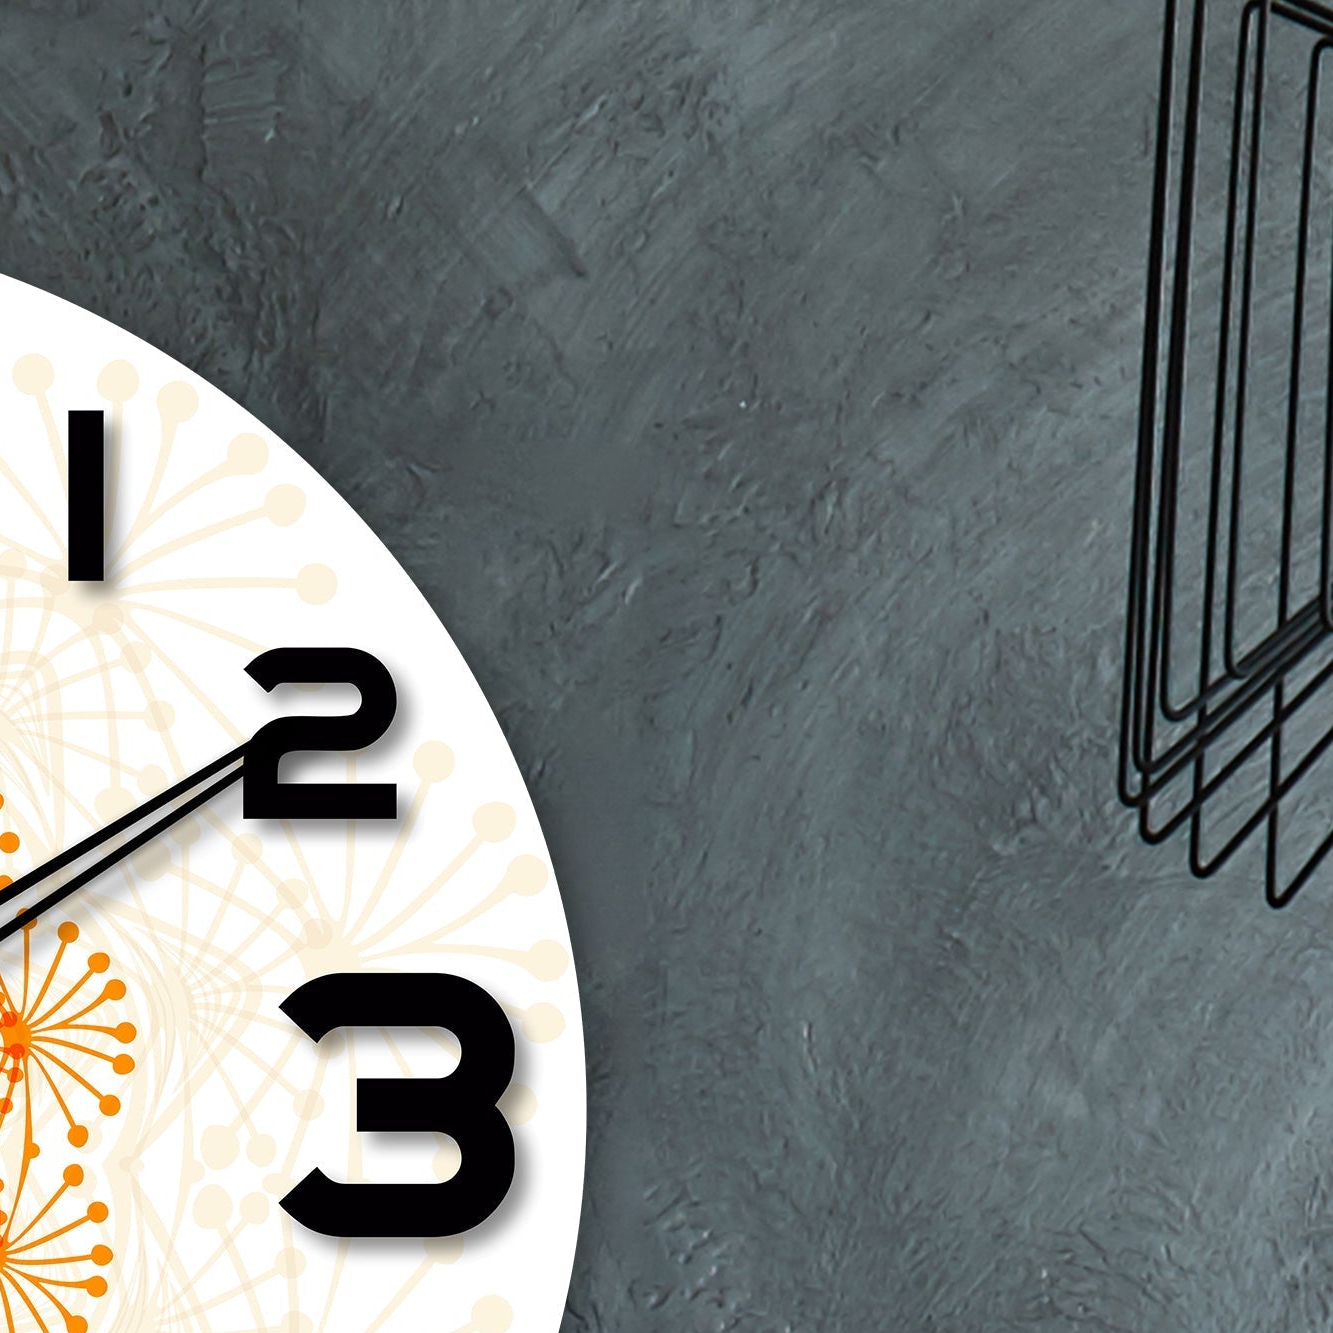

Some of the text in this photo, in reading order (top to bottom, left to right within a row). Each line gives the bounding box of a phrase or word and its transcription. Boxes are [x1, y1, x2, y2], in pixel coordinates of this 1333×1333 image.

[69, 410, 104, 582] 1
[243, 647, 397, 820] 2
[279, 973, 516, 1238] 3
